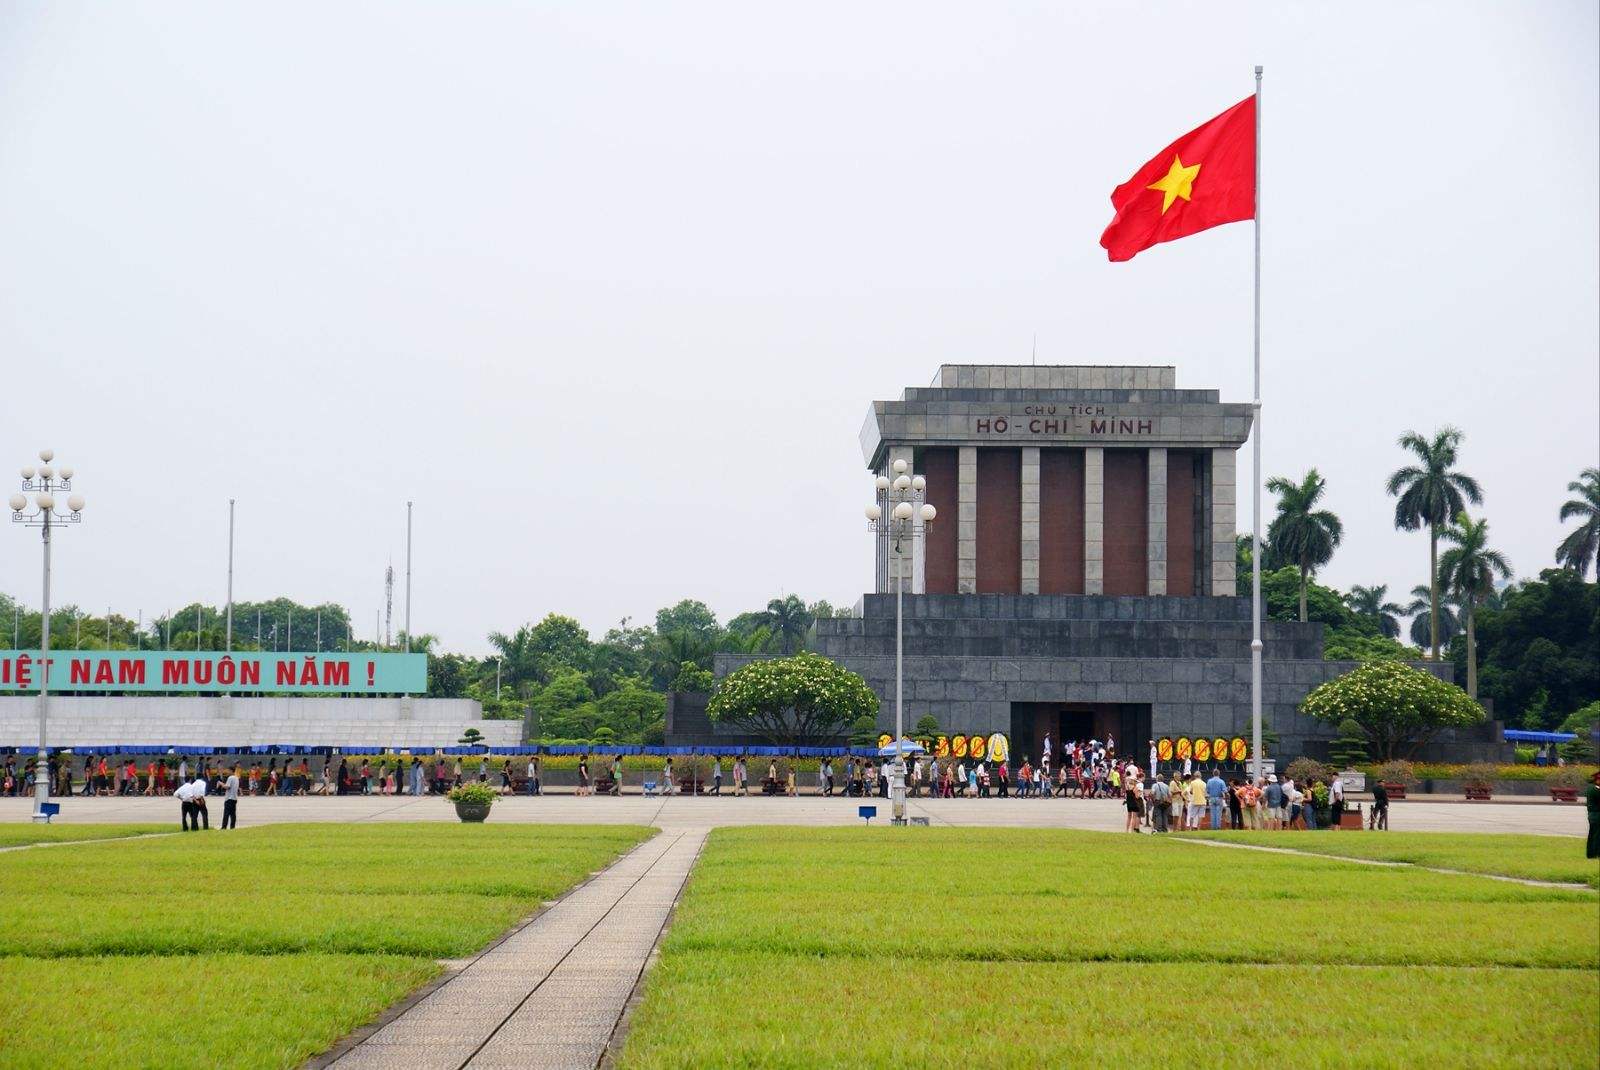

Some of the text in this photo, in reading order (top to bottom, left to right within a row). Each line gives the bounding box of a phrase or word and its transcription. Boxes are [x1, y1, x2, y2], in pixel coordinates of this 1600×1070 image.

[70, 659, 146, 685] NAM
[162, 655, 260, 686] MUÔN
[276, 655, 349, 686] NĂM
